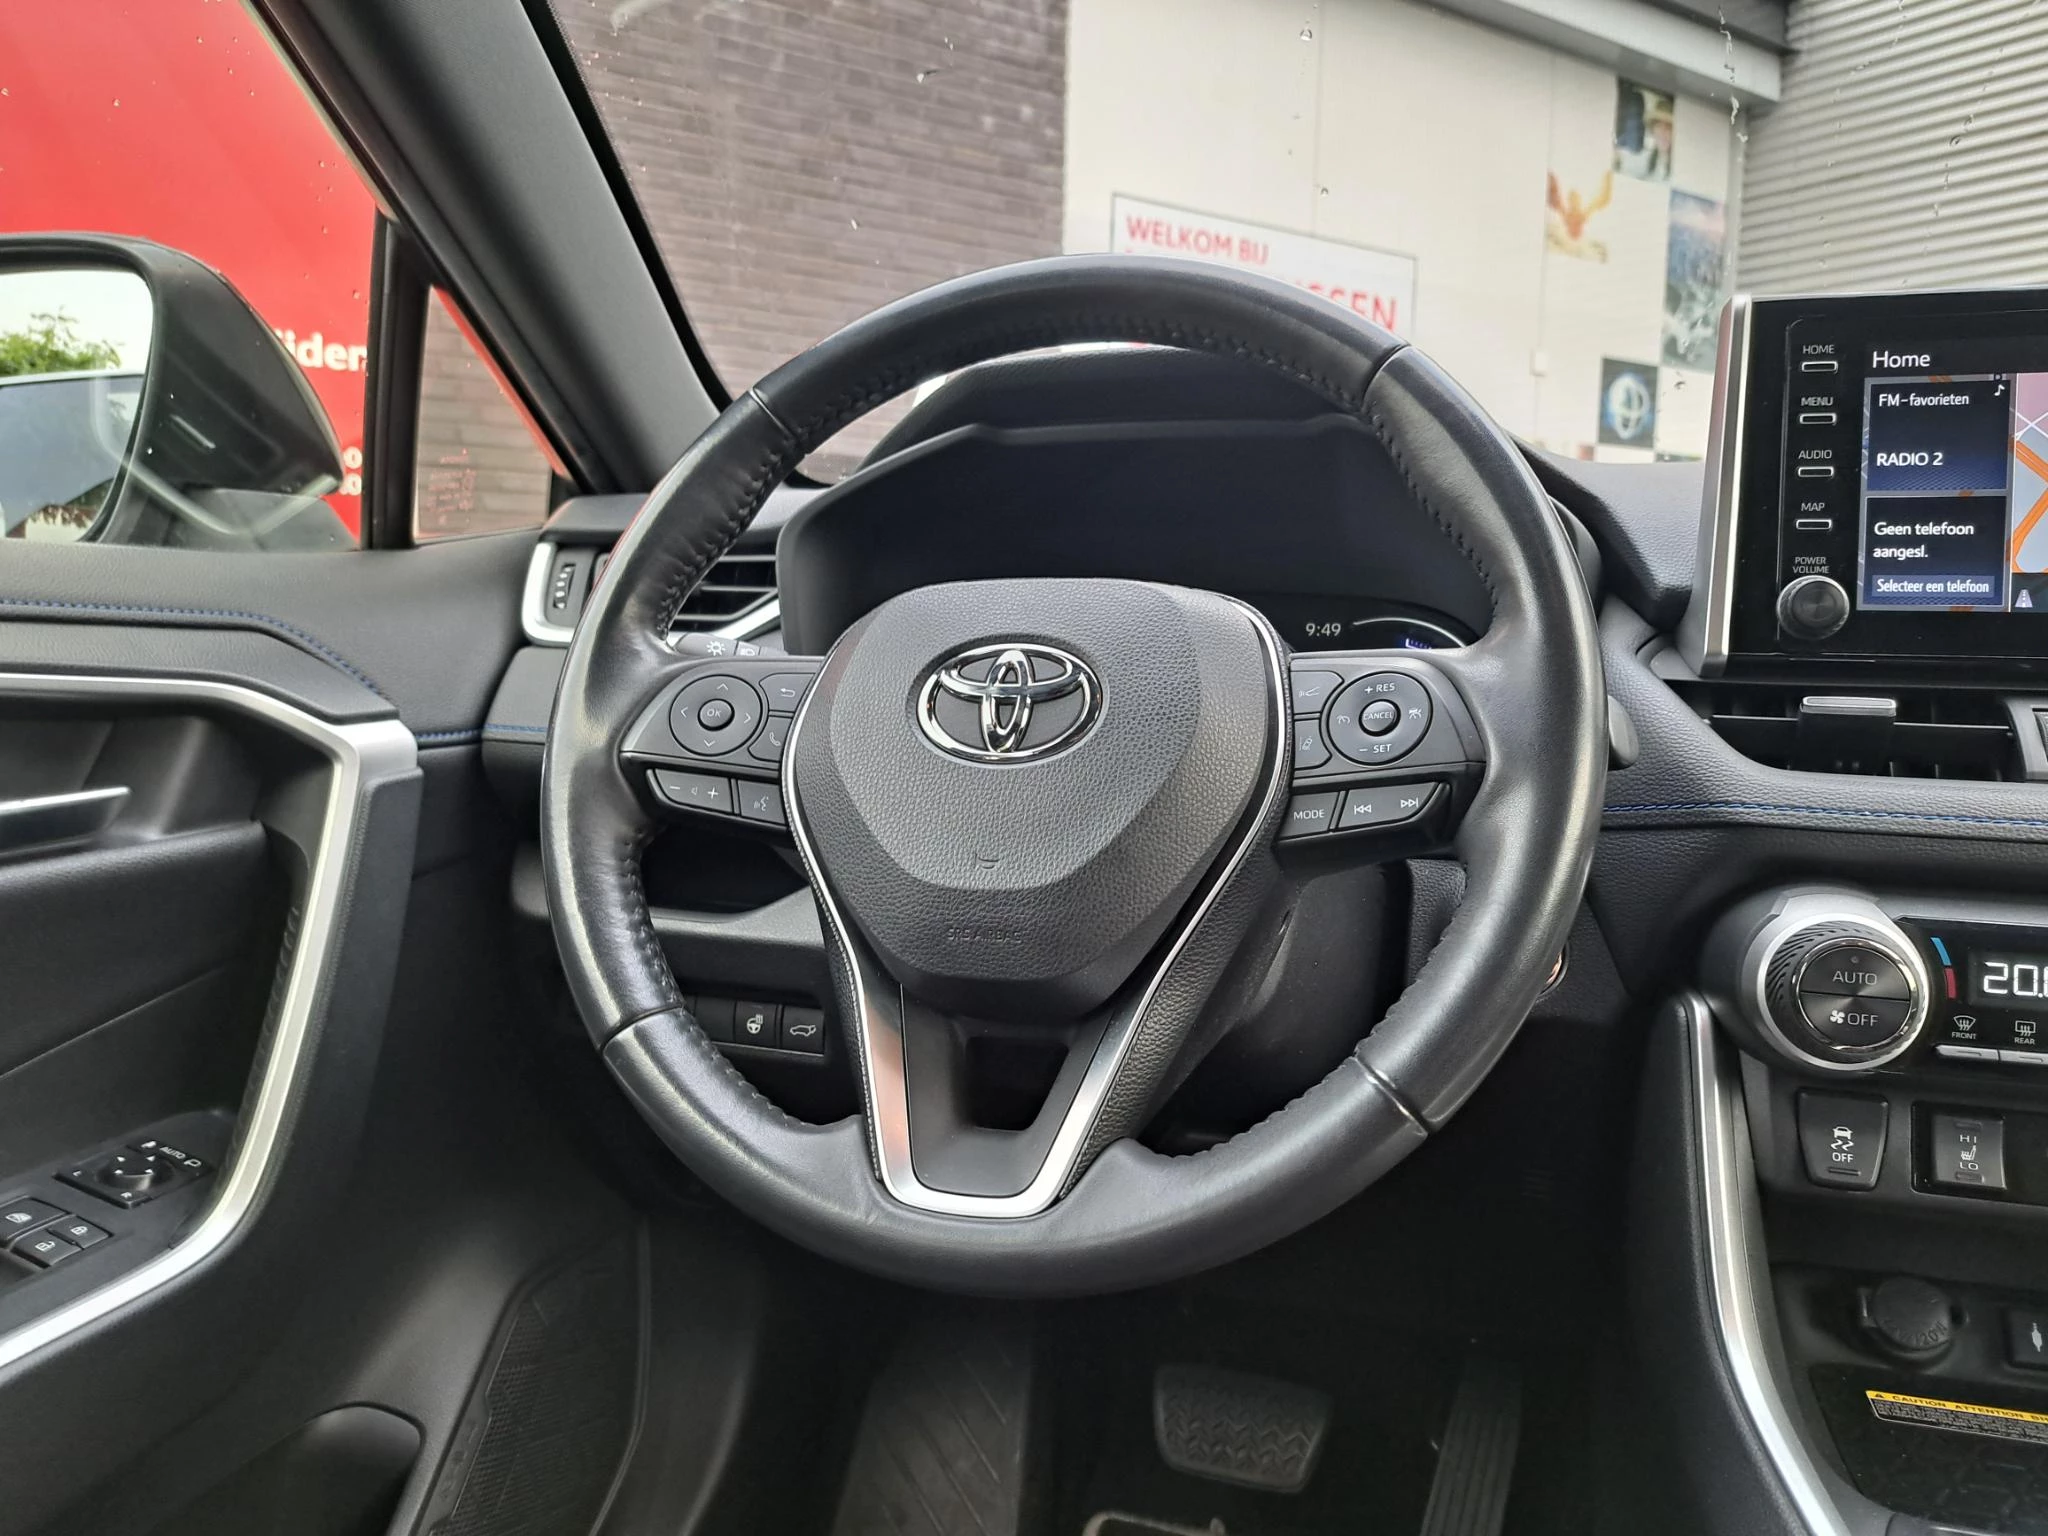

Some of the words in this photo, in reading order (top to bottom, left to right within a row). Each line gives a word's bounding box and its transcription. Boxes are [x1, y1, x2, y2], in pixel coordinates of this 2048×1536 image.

[1125, 214, 1233, 254] WELKOM
[1238, 238, 1270, 266] BIJ
[1802, 344, 1835, 355] HOME
[1872, 350, 1931, 369] Home
[1800, 396, 1834, 407] MENU
[1878, 392, 1970, 408] FM-favorieten
[1798, 449, 1833, 460] AUDIO
[1876, 452, 1930, 467] RADIO
[1932, 451, 1944, 466] 2
[1800, 501, 1826, 512] MAP
[1873, 521, 1912, 537] Geen
[1914, 521, 1975, 536] telefoon
[1872, 543, 1929, 561] aangesl.
[1794, 556, 1827, 566] POWER
[1792, 565, 1830, 575] VOLUME
[1876, 578, 1924, 593] Selecteer
[1925, 581, 1944, 593] een
[1946, 579, 1990, 593] telefoon
[1305, 622, 1342, 637] 9:49
[1375, 682, 1396, 693] RES
[706, 708, 721, 718] OK
[1363, 711, 1394, 721] CANCEL
[1373, 743, 1392, 754] SET
[1293, 808, 1325, 821] MODE
[1832, 970, 1878, 986] AUTO
[1983, 961, 2048, 1000] 20.
[1847, 1013, 1879, 1027] OFF
[1951, 1031, 1977, 1040] FRONT
[2014, 1036, 2036, 1045] REAR
[1832, 1152, 1854, 1163] OFF
[1959, 1162, 1979, 1171] LO
[1891, 1395, 1947, 1408] CAUTION
[1955, 1404, 2024, 1419] ATTENTION
